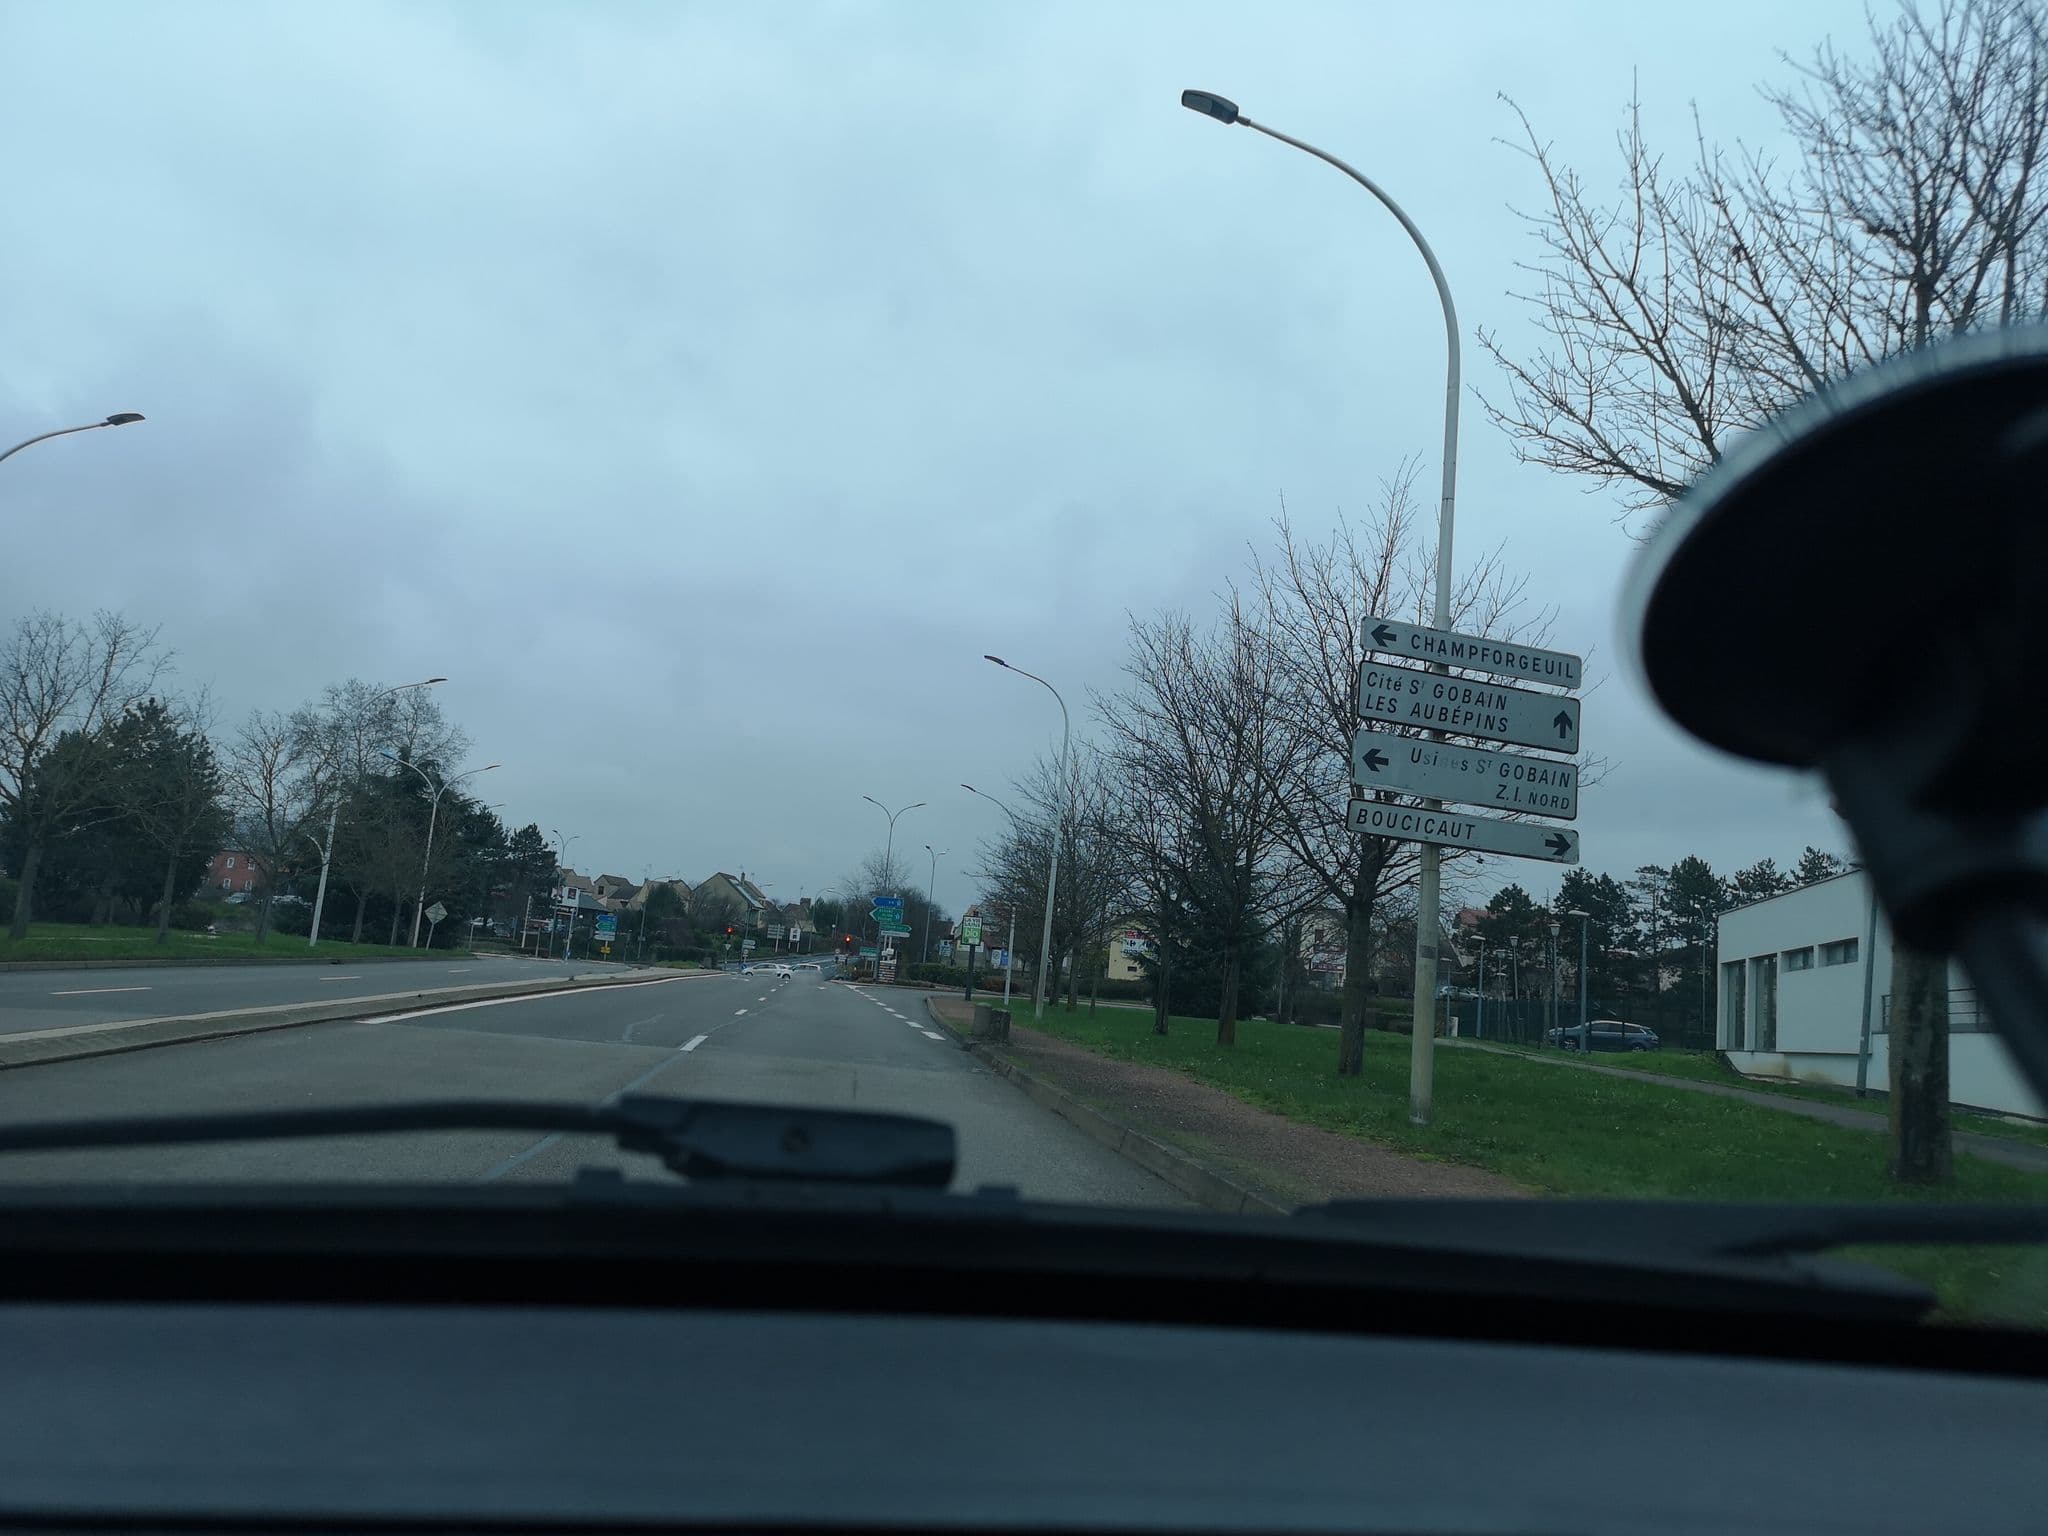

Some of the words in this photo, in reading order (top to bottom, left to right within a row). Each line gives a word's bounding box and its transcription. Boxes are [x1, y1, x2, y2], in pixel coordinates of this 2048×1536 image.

[1411, 634, 1574, 677] CHAMPFORGEUIL
[1367, 671, 1402, 690] Cité
[1434, 684, 1508, 710] GOBAIN
[1365, 694, 1398, 713] LES
[1410, 703, 1508, 733] AUBÉPINS
[1411, 747, 1469, 771] Usies
[1499, 763, 1570, 788] GOBAIN
[1529, 791, 1570, 810] NORD
[1357, 808, 1476, 840] BOUCICAUT
